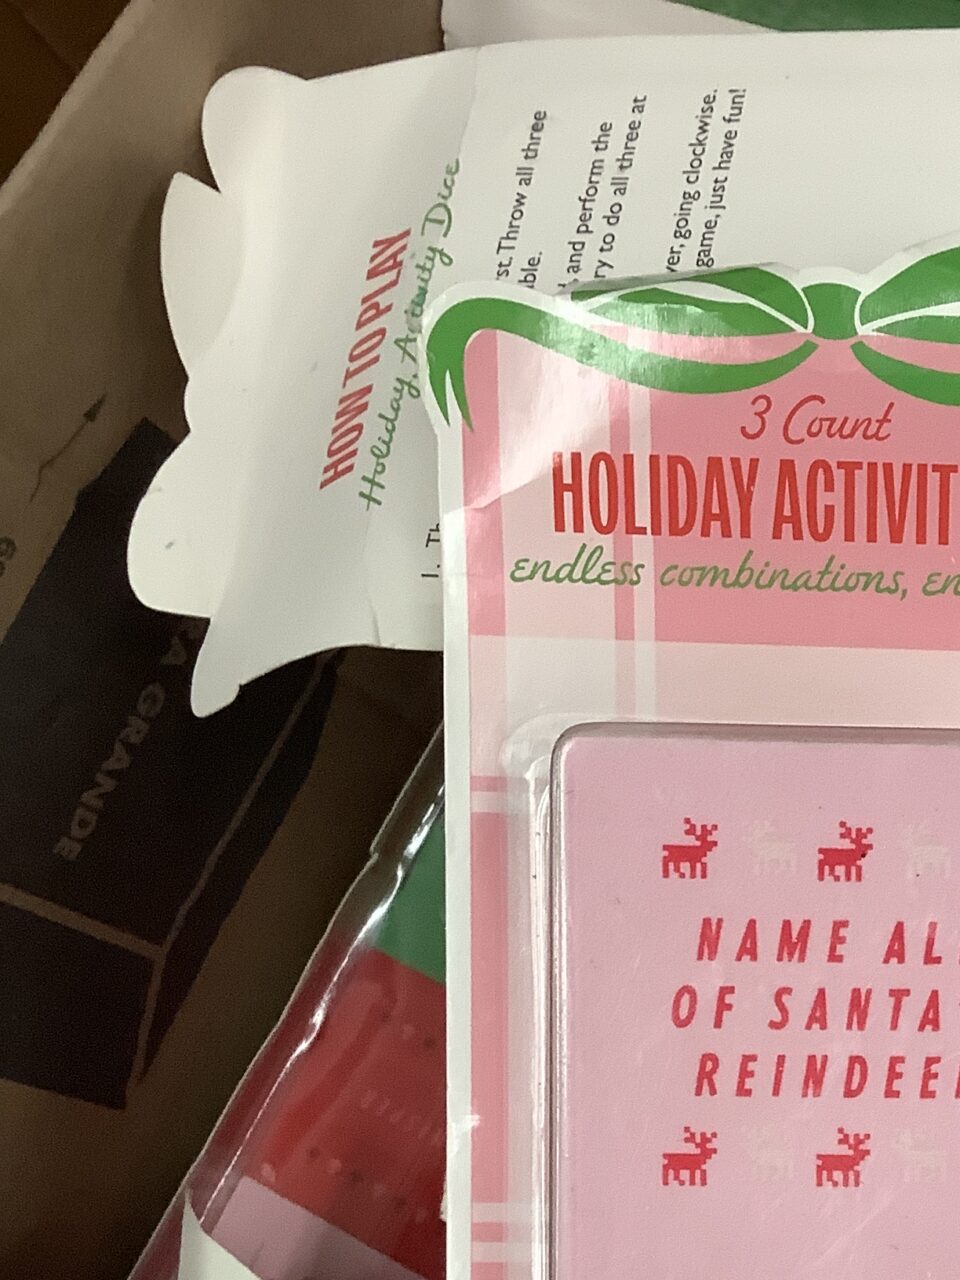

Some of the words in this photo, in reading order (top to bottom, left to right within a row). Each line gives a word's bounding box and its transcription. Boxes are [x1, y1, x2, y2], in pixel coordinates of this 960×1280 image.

[631, 94, 647, 114] at
[722, 88, 747, 124] fun!
[521, 109, 547, 160] three
[615, 119, 642, 171] three
[682, 88, 718, 185] clockwise.
[712, 129, 738, 172] have
[515, 166, 534, 187] all
[567, 241, 585, 274] and
[576, 158, 605, 235] perform
[591, 121, 613, 153] the
[611, 176, 629, 196] all
[704, 176, 728, 210] just
[496, 192, 528, 256] Throw
[603, 201, 623, 227] do
[674, 190, 701, 240] going
[600, 232, 616, 254] to
[696, 213, 722, 268] game,
[355, 227, 412, 332] PLAY
[342, 327, 388, 389] TO
[358, 372, 420, 511] Holiday
[421, 157, 460, 238] Dice
[320, 382, 374, 491] HOW
[740, 396, 770, 443] 3
[782, 394, 895, 446] Count
[552, 451, 760, 540] HOLIDAY
[510, 543, 645, 588] endless
[660, 549, 909, 601] combinations,
[51, 681, 166, 861] GRANDE
[696, 917, 850, 964] NAME
[671, 984, 736, 1029] OF
